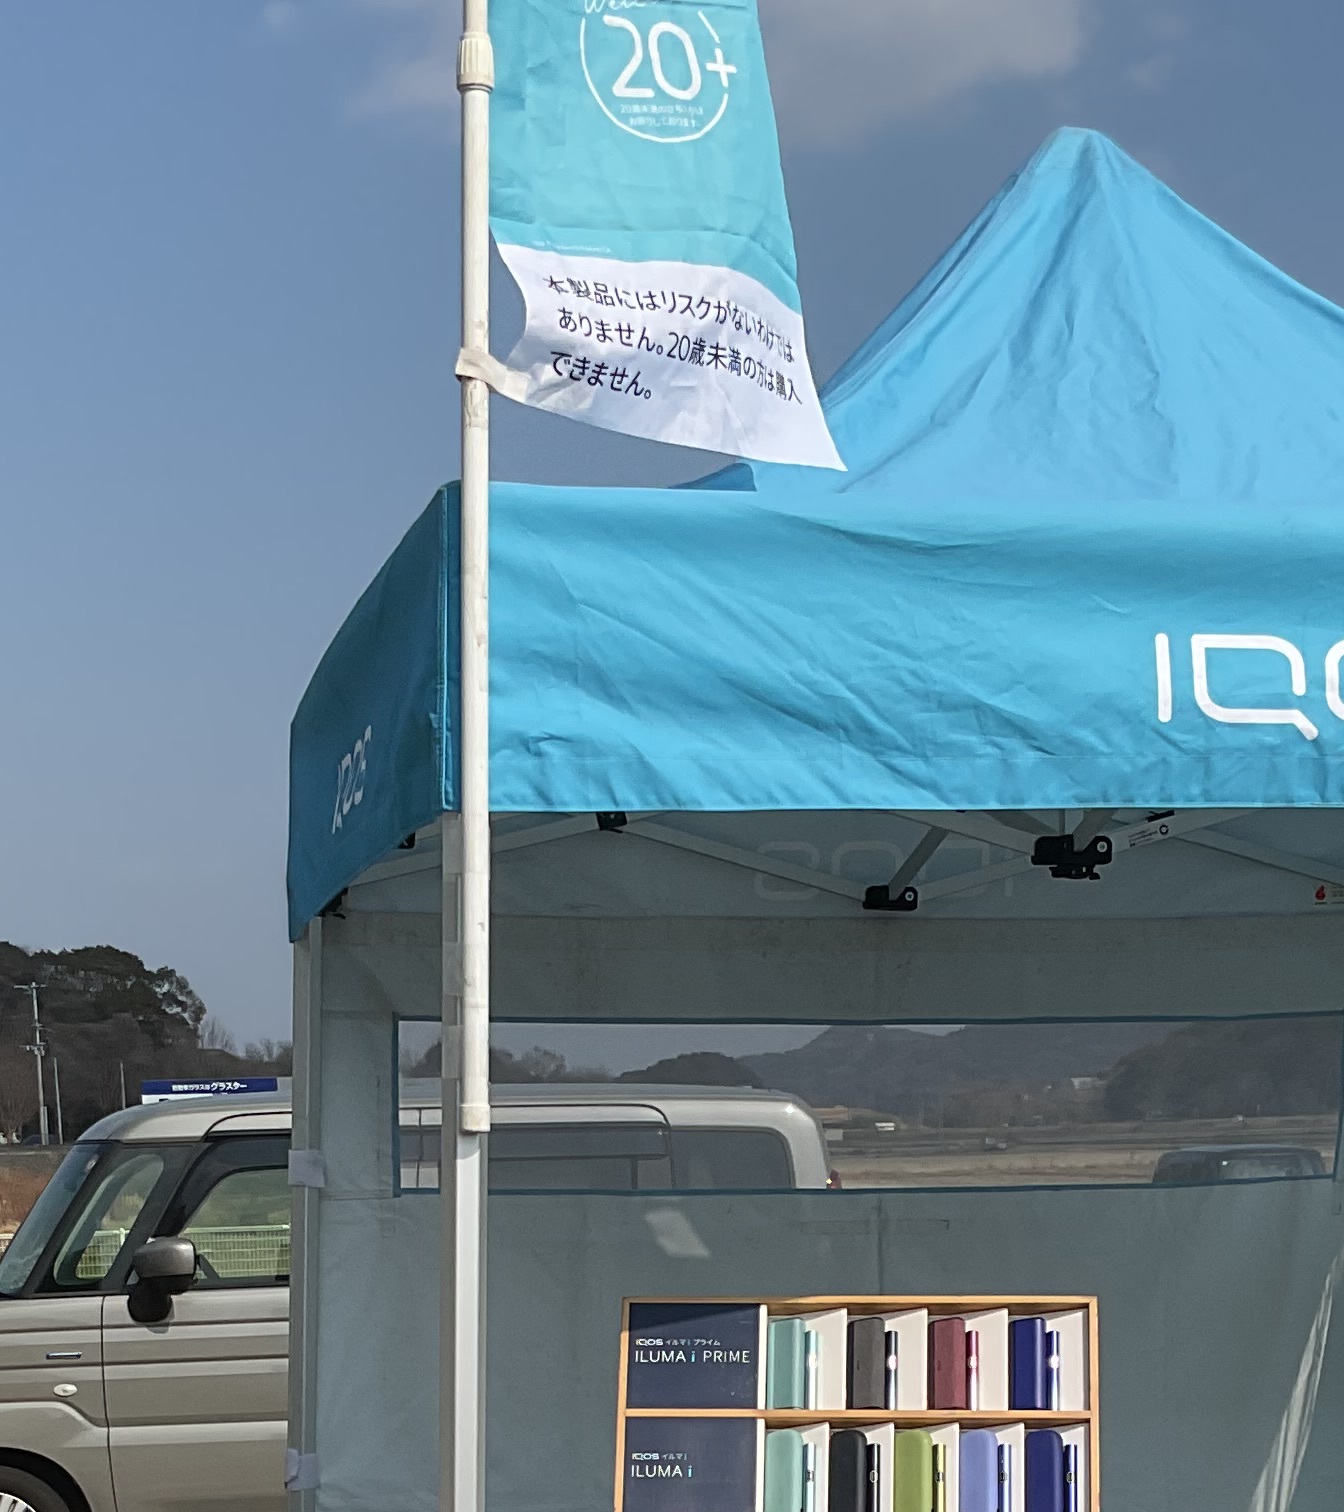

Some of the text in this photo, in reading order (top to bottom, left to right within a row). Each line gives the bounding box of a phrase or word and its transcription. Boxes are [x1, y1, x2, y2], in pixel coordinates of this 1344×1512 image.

[550, 350, 653, 400] できません。
[635, 1350, 686, 1363] ILUMA
[703, 1350, 750, 1363] PRIME
[631, 1464, 683, 1478] ILUMA
